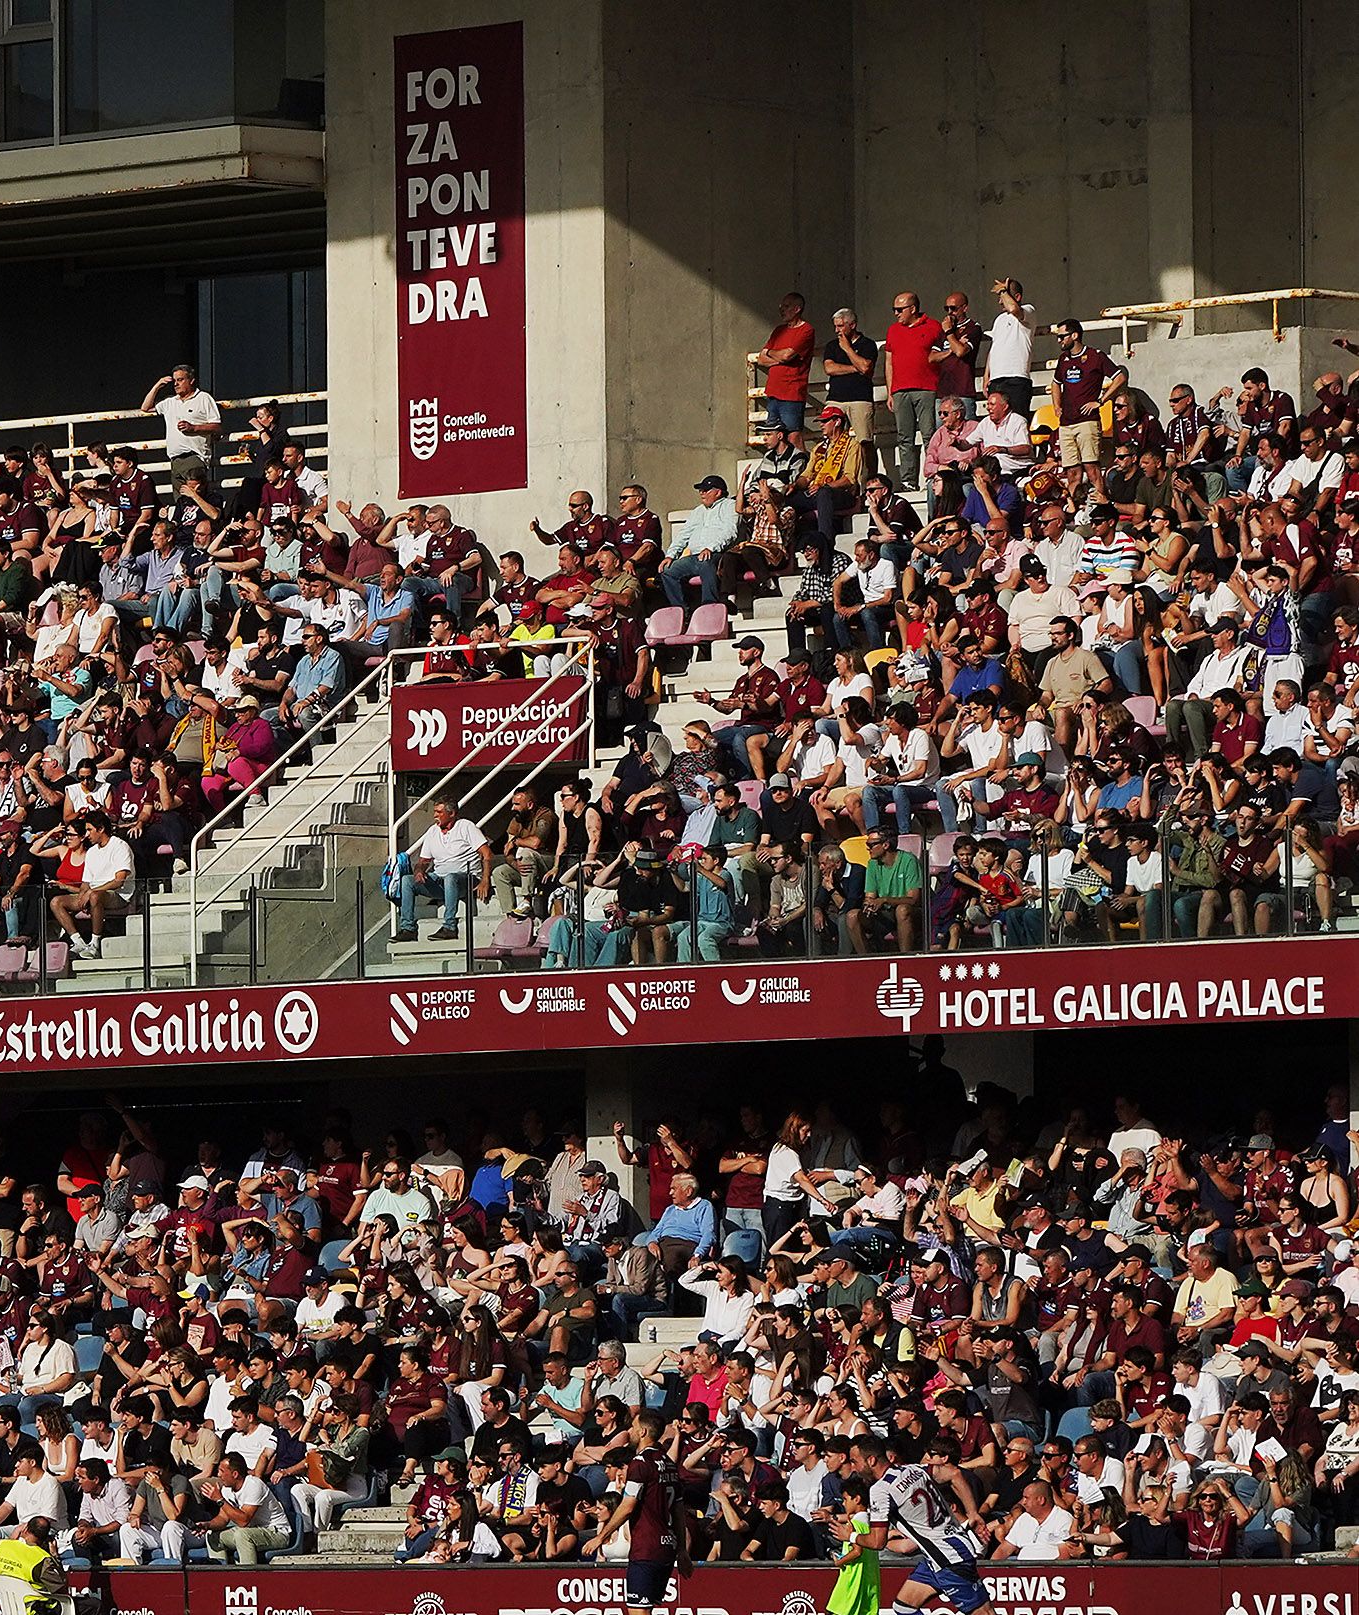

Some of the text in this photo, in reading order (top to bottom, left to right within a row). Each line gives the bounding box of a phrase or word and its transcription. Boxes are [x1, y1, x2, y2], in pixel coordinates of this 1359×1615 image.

[407, 65, 482, 112] FOR
[406, 121, 458, 165] ZA
[407, 169, 490, 218] PON
[407, 222, 497, 271] TEVE
[408, 277, 489, 325] DRA
[443, 412, 486, 427] Concello
[443, 425, 515, 442] de Pontevedra
[462, 698, 570, 729] Deputación
[462, 725, 570, 748] Pontevedra
[536, 986, 574, 1000] GALICIA
[640, 980, 696, 996] DEPORTE
[759, 977, 799, 991] GALICIA
[421, 990, 476, 1005] DEPORTE
[536, 998, 586, 1012] SAUDABLE
[641, 995, 690, 1012] GALEGO
[759, 989, 811, 1004] SAUDABLE
[939, 976, 1325, 1028] HOTEL GALICIA PALACE
[421, 1005, 470, 1021] GALEGO
[130, 998, 266, 1056] Galicia
[557, 1576, 678, 1602] CONSES
